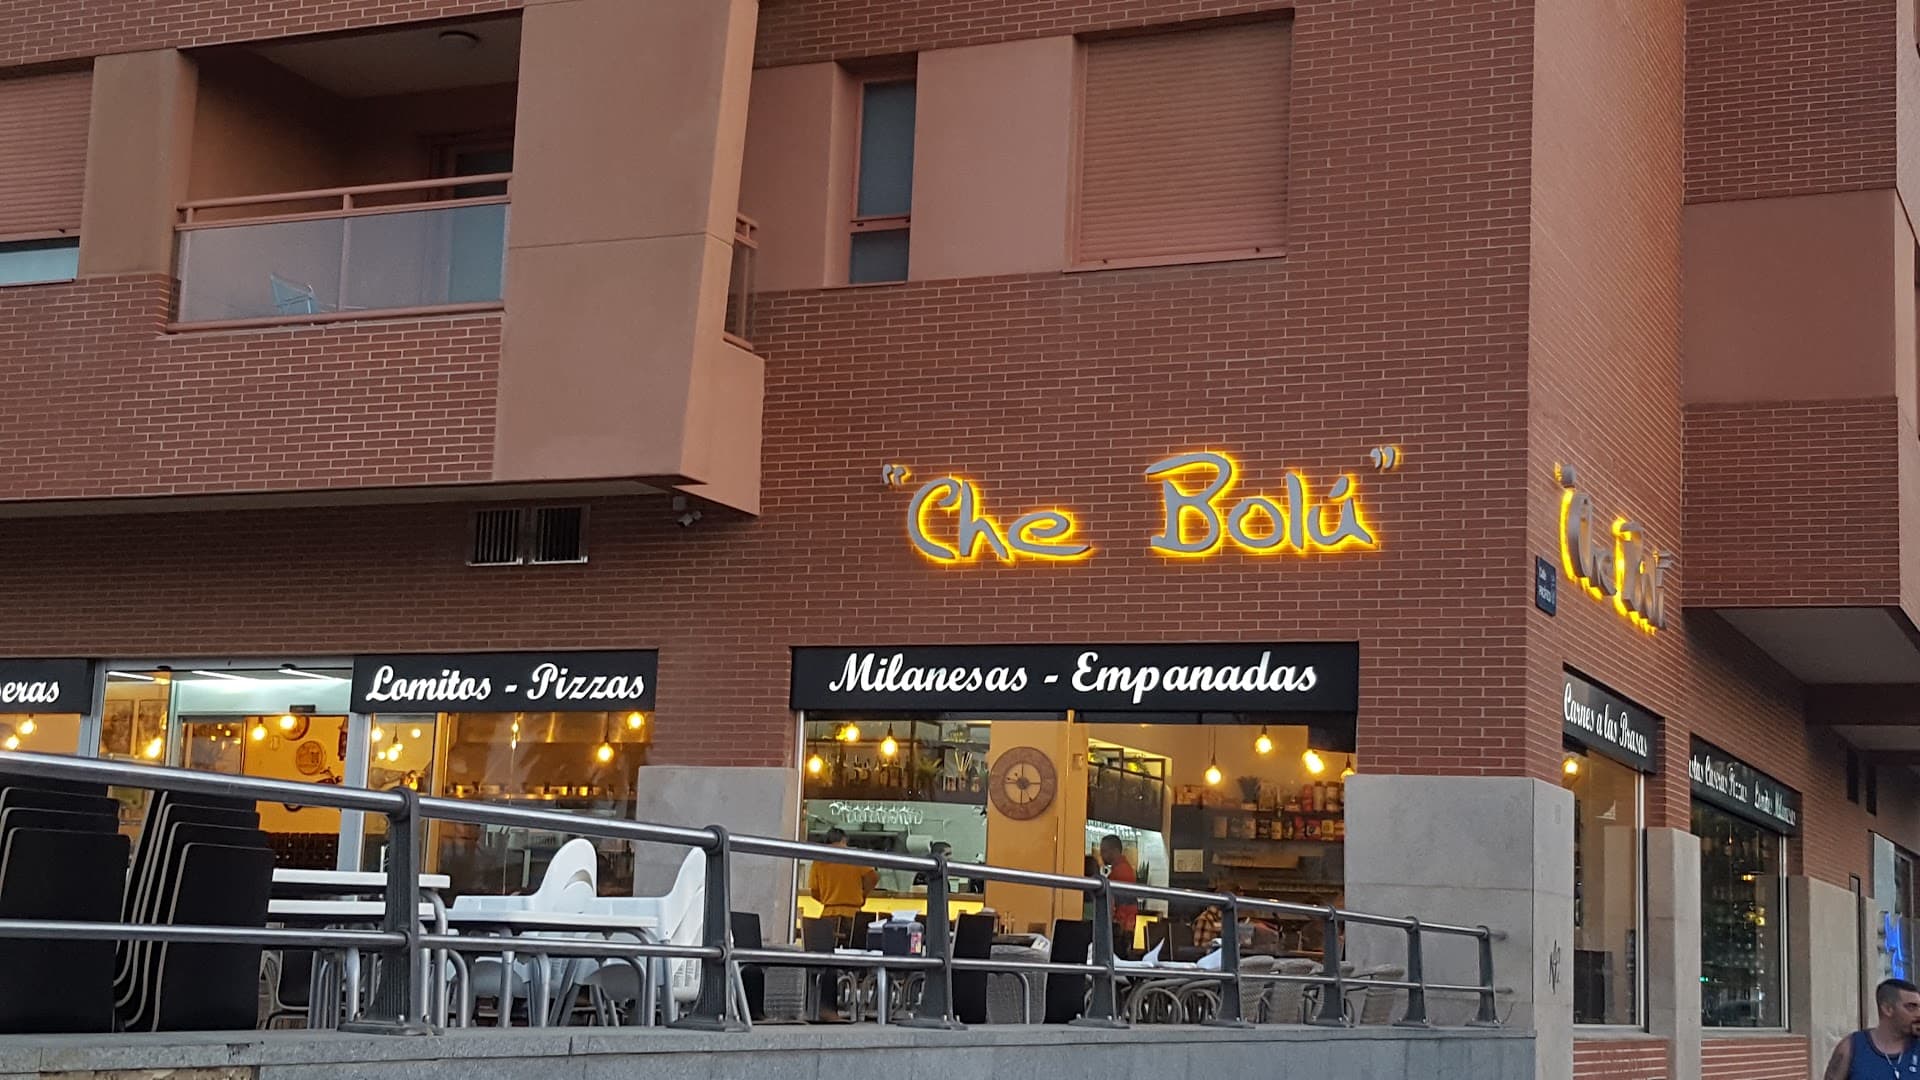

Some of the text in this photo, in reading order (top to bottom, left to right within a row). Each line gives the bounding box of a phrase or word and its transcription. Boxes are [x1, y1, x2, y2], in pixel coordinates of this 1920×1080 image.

[365, 661, 645, 702] Lomitos - Pizzas
[828, 650, 1317, 705] Milanesas - Empanadas
[1563, 682, 1648, 758] Carnes a las Brasas
